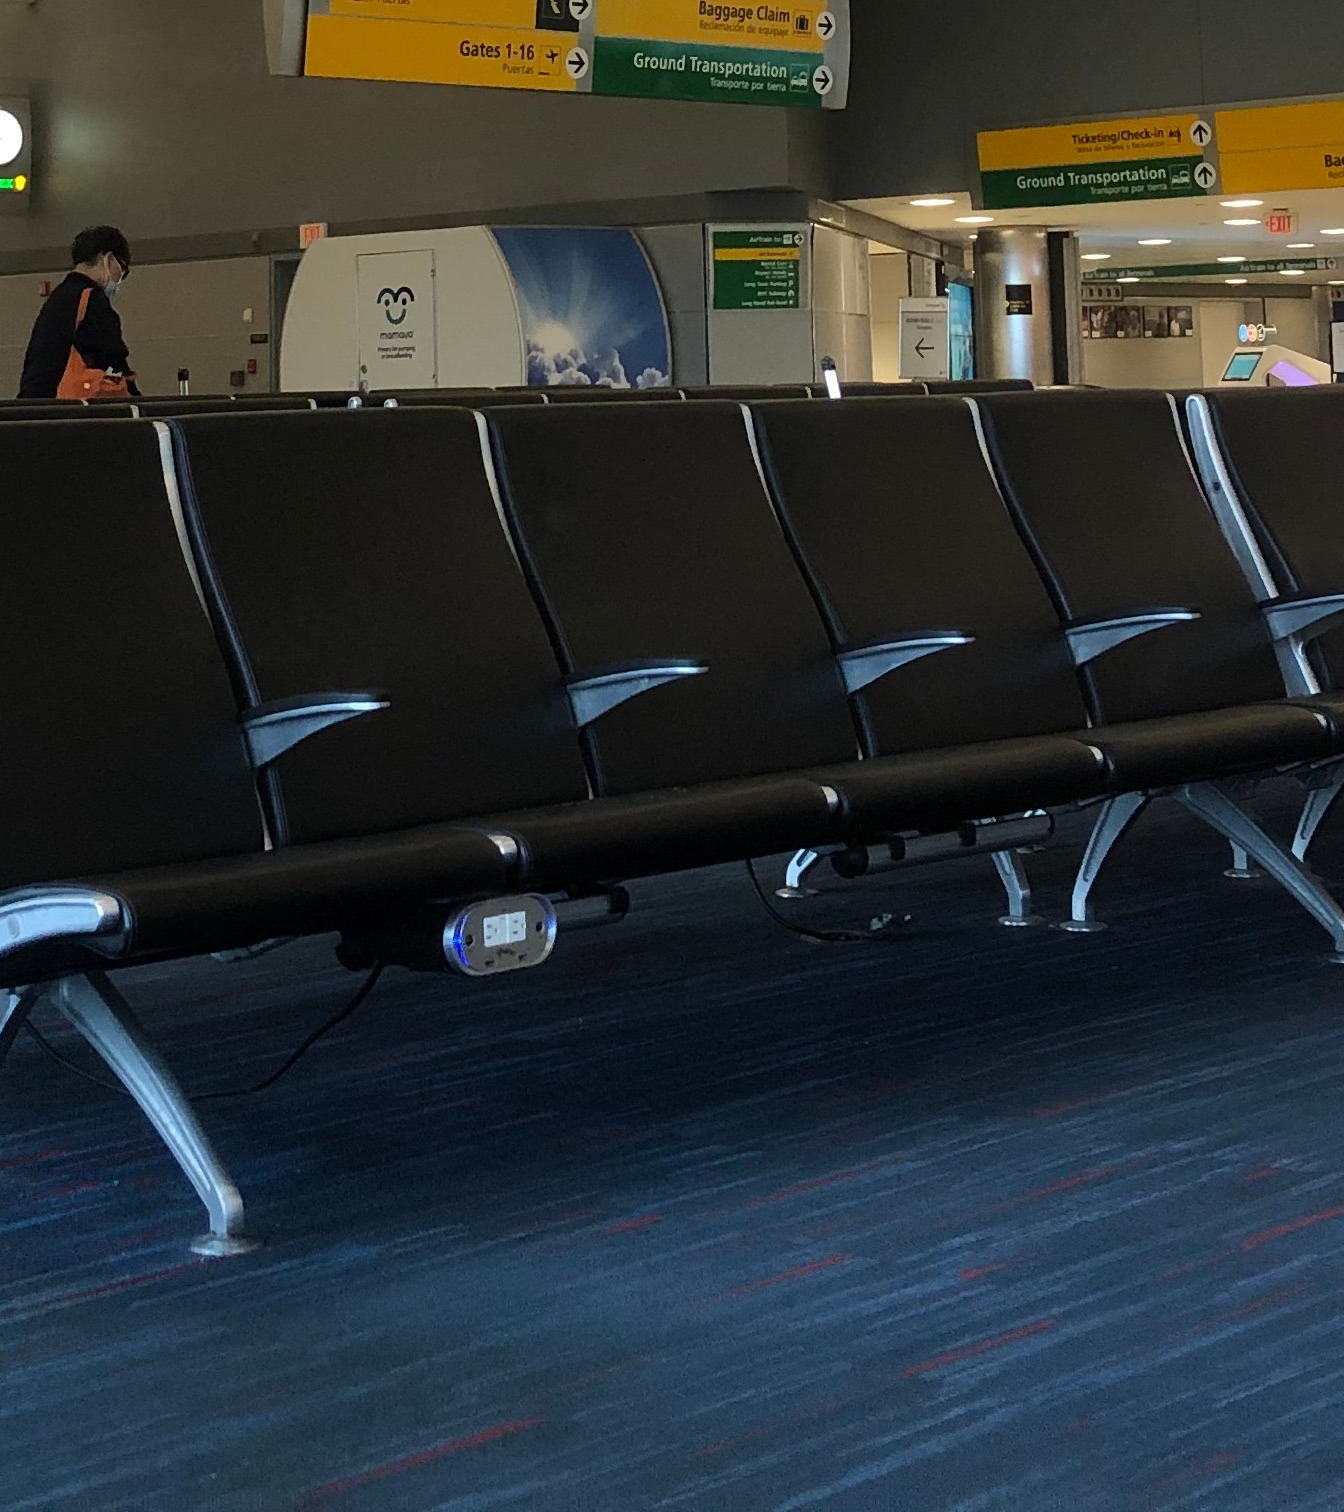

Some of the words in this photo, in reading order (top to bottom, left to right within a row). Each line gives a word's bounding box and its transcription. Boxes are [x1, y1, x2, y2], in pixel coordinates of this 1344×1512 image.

[699, 0, 753, 22] Baggage
[757, 6, 790, 22] Claim
[747, 24, 756, 32] de
[758, 25, 788, 37] equipaje
[460, 40, 501, 59] Gates
[506, 43, 535, 60] 1-16
[503, 64, 534, 76] Puertas
[634, 52, 686, 70] Ground
[690, 56, 788, 78] Transportation
[710, 77, 750, 90] Transporte
[752, 81, 764, 91] por
[1072, 127, 1164, 145] Ticketing/Check-in
[1016, 172, 1064, 189] Ground
[1068, 166, 1166, 186] Transportation
[1131, 184, 1144, 194] por
[1269, 215, 1292, 232] EXIT
